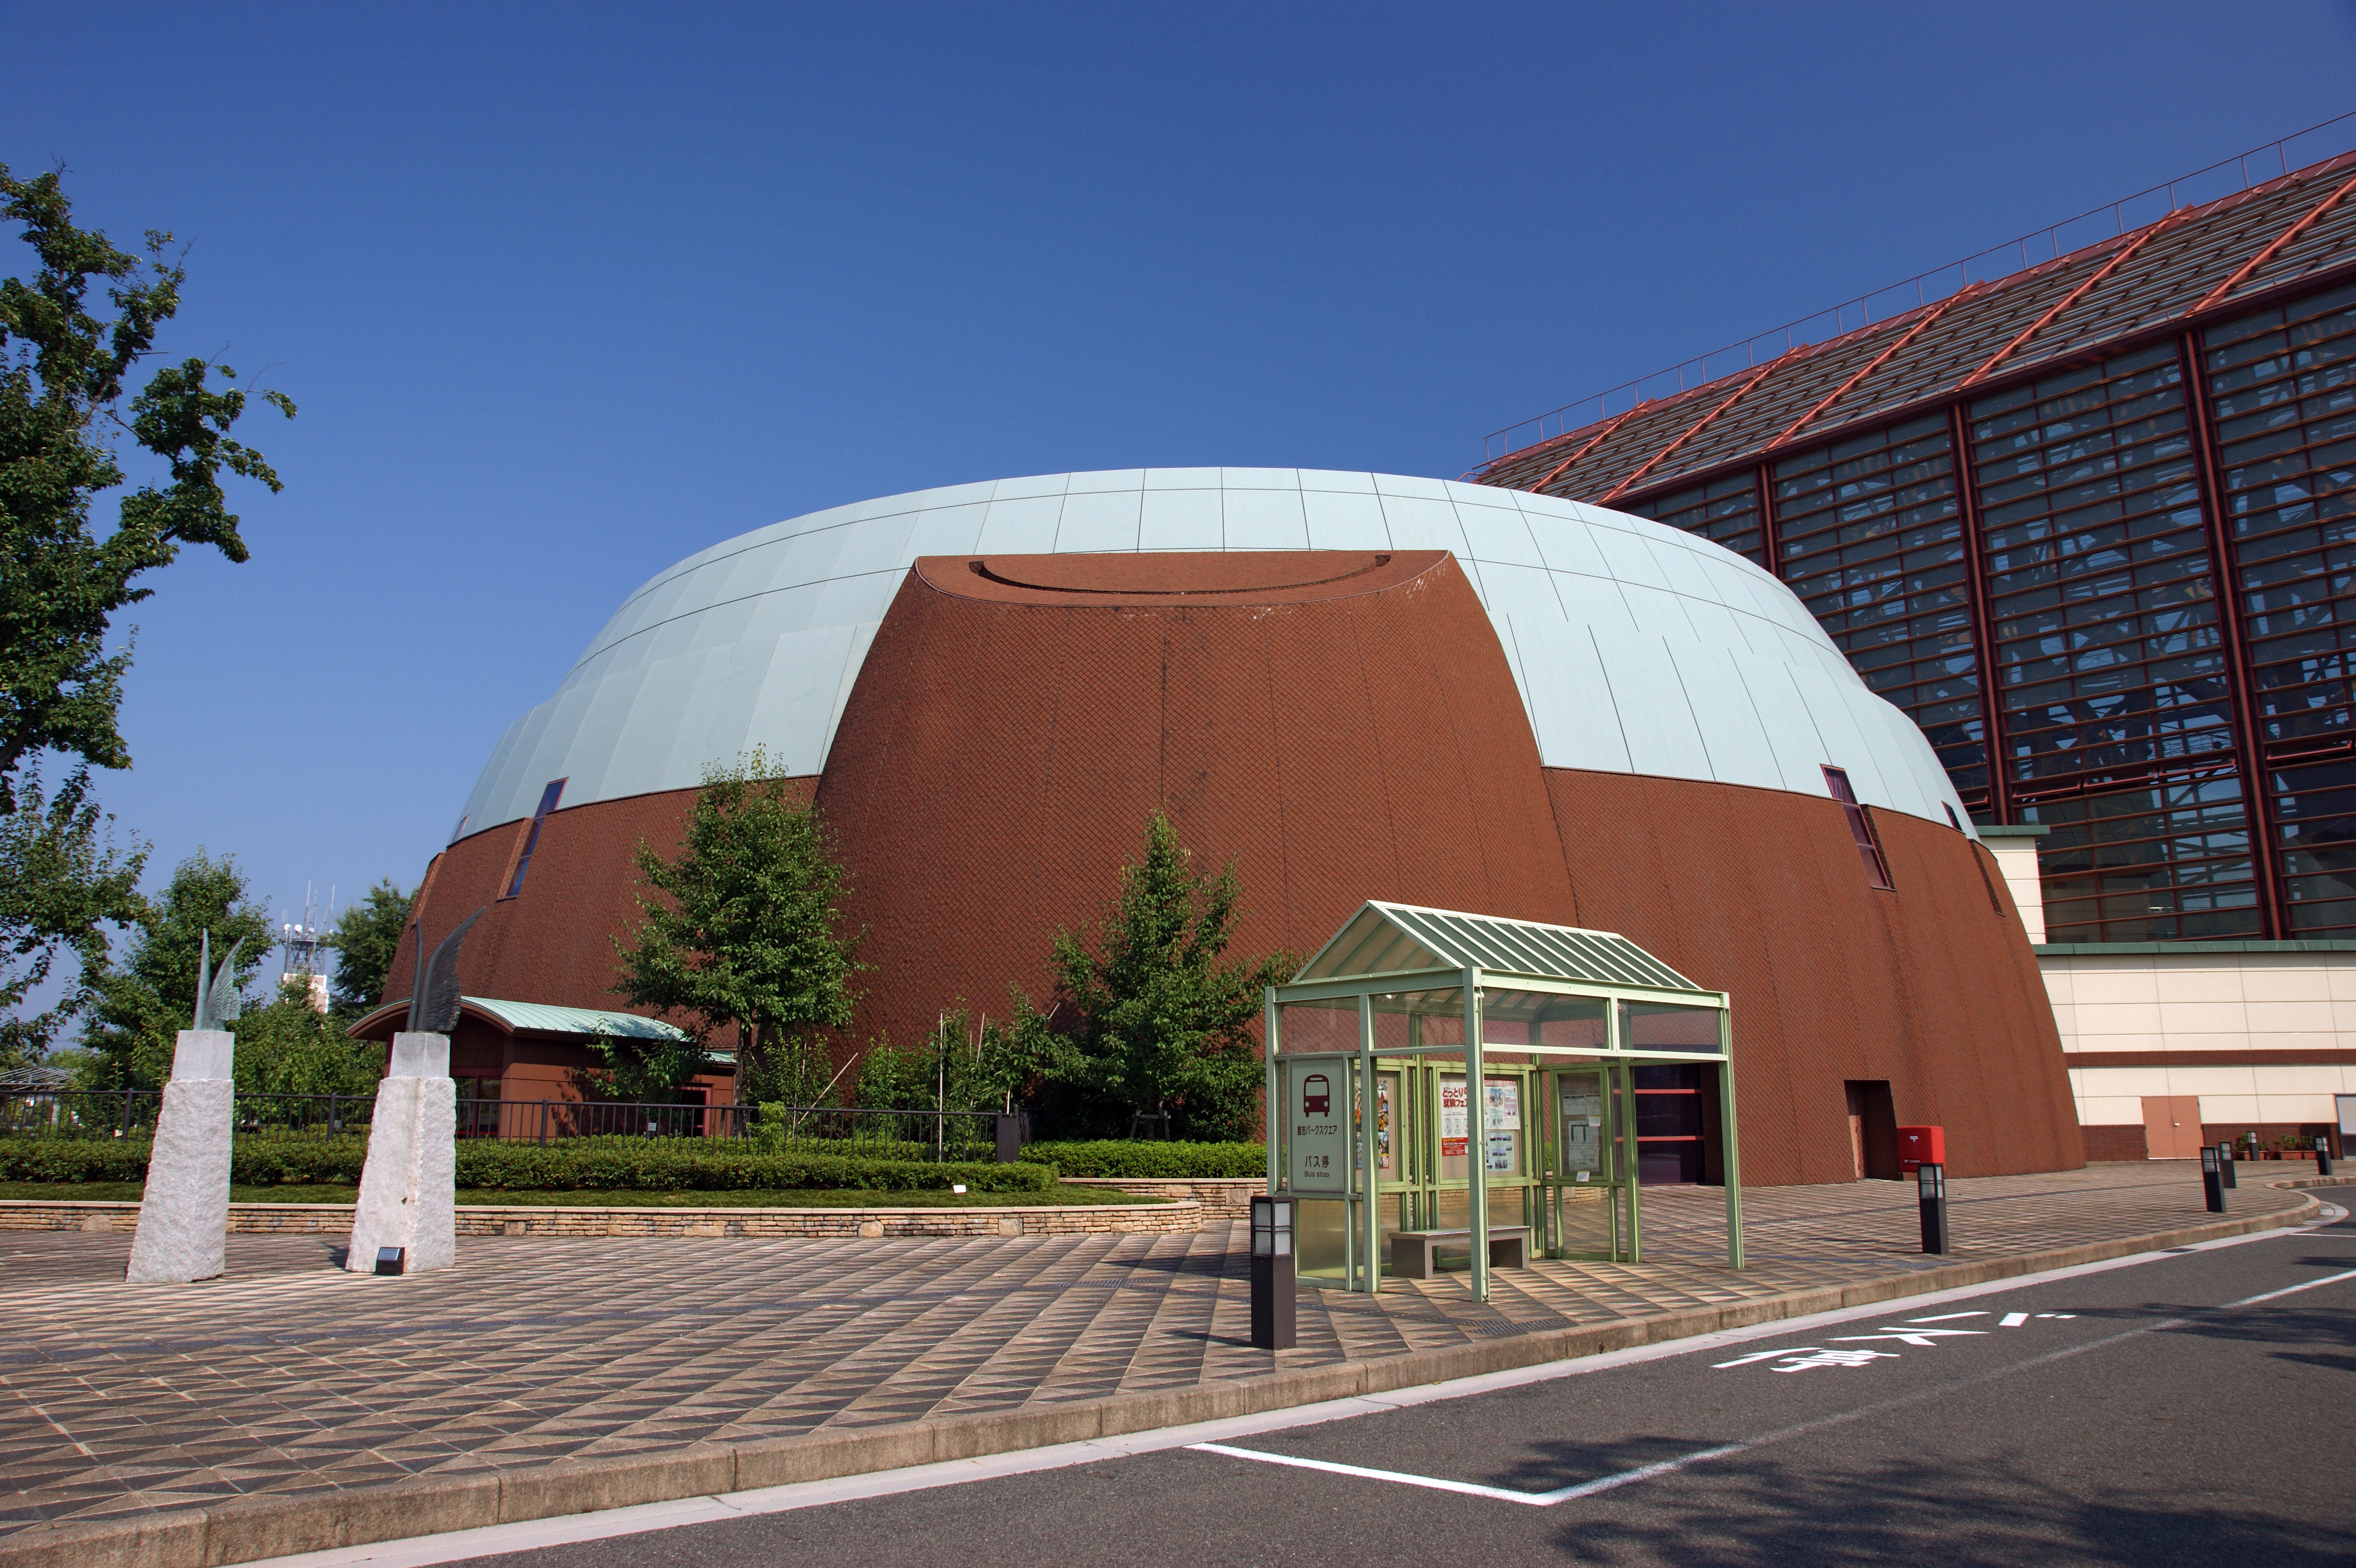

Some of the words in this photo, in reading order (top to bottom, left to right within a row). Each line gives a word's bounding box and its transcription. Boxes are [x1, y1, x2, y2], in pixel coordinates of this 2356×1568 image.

[1442, 1087, 1463, 1097] とっとり
[1297, 1125, 1338, 1135] 倉吉パークスクエア
[1305, 1155, 1329, 1168] バス停
